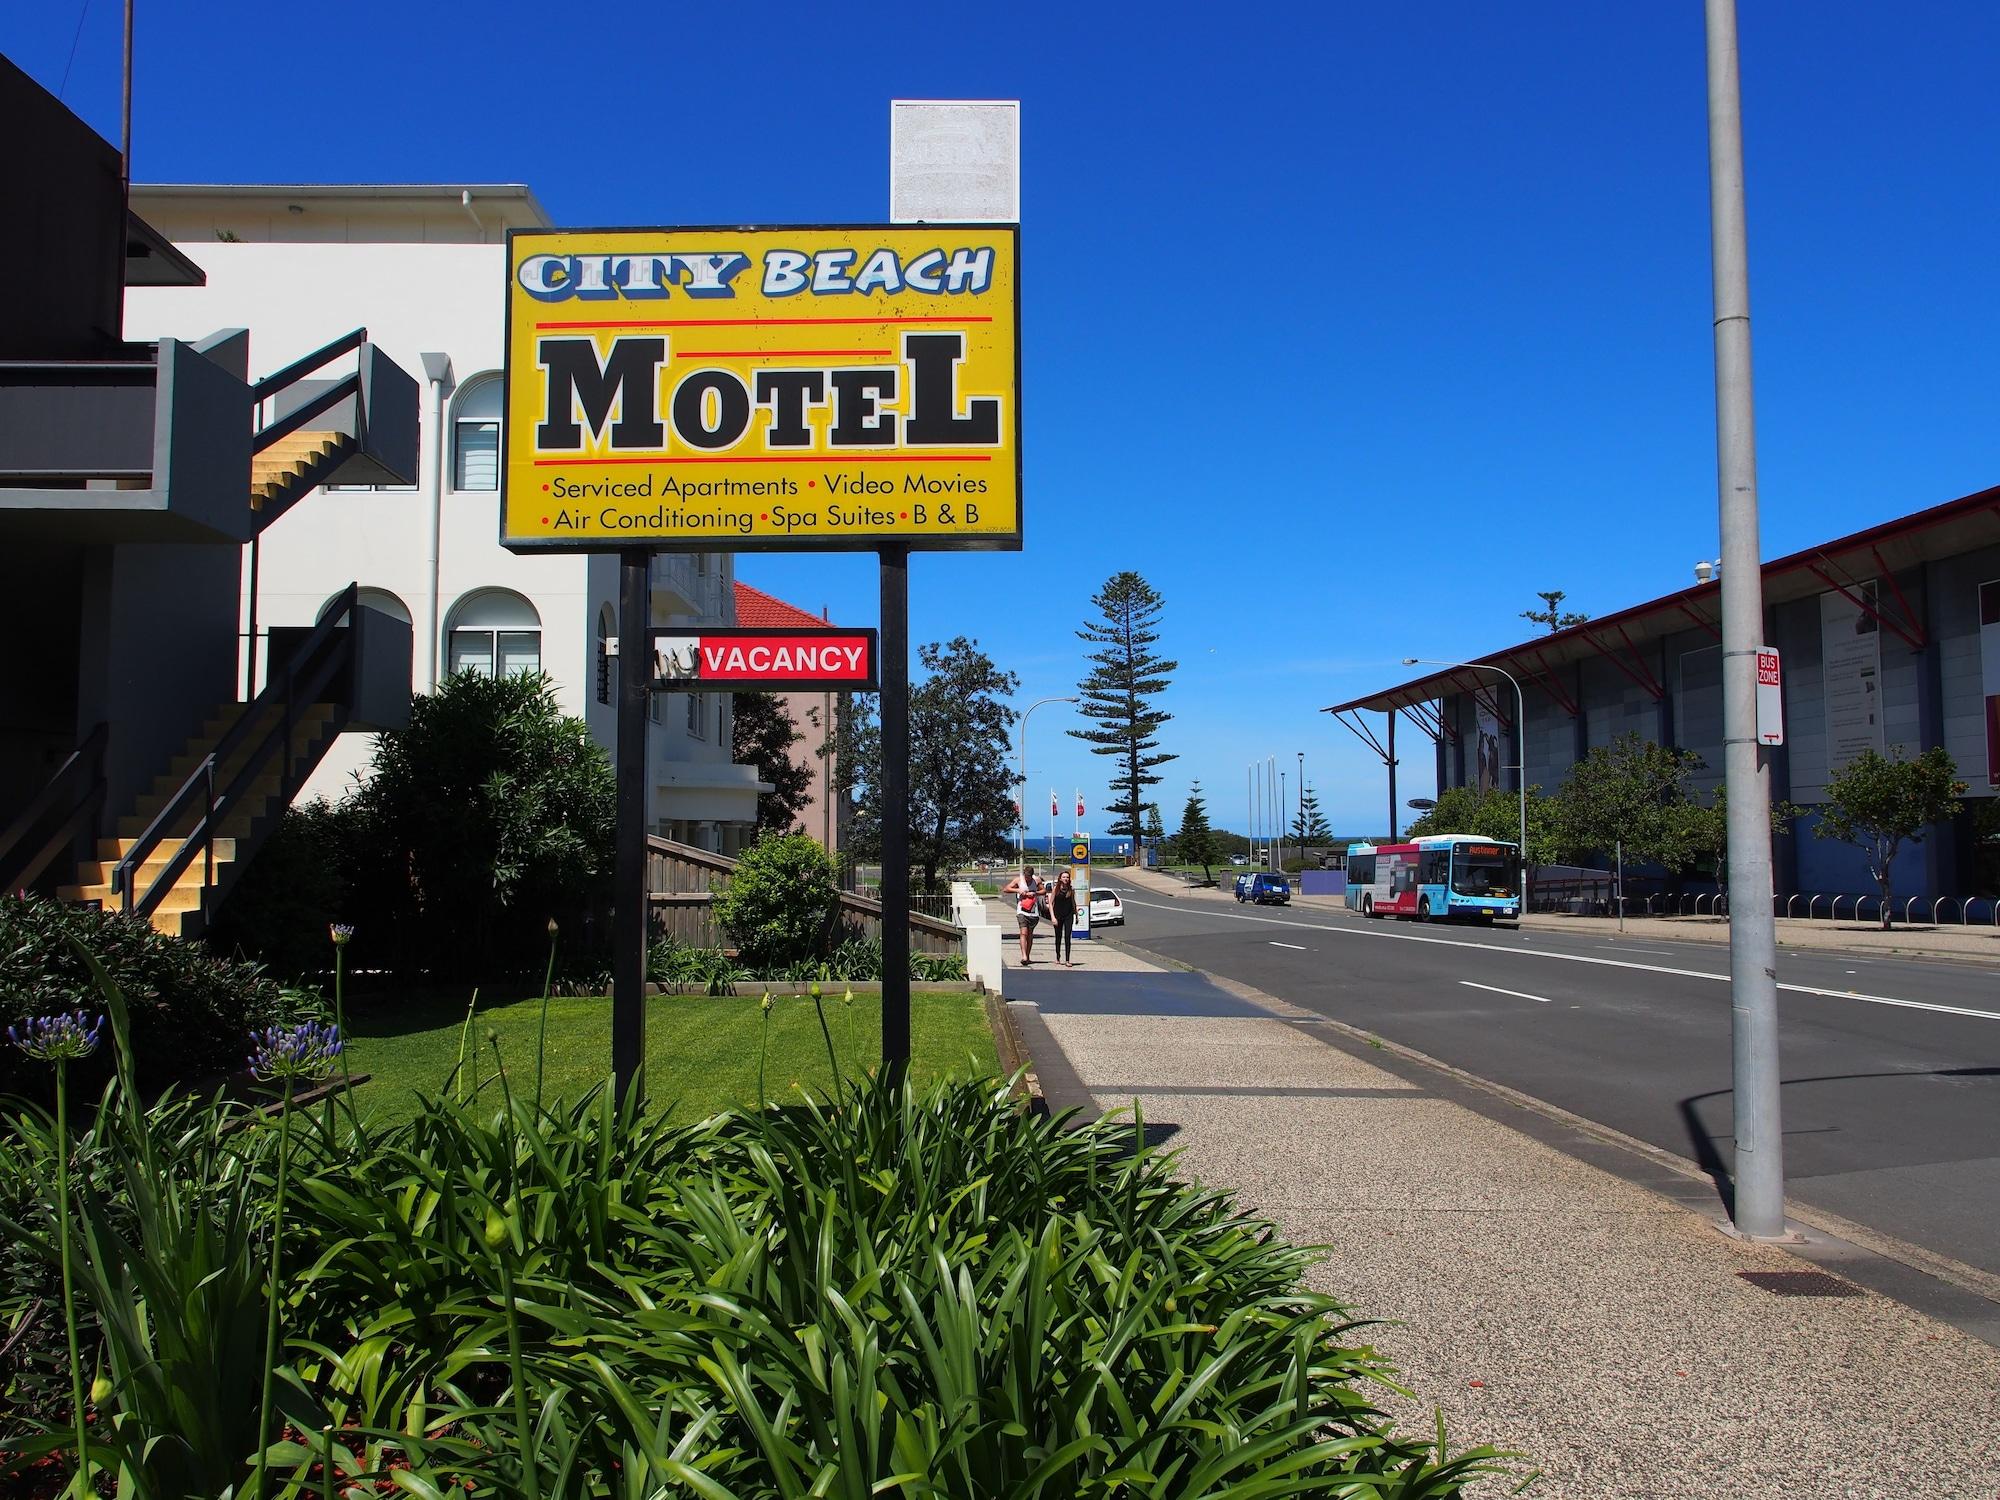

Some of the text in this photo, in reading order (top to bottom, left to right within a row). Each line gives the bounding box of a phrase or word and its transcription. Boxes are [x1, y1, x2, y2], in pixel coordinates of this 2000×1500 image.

[517, 247, 996, 303] CITY BEACH
[535, 330, 1003, 453] MOTEL
[552, 473, 798, 502] Serviced Apartments
[823, 471, 988, 495] Video Movies
[553, 505, 753, 533] Air Conditioning
[771, 505, 895, 532] Spa Suites
[914, 503, 979, 524] B & B
[705, 646, 863, 672] VACANCY
[1760, 655, 1775, 669] BUS
[1758, 669, 1778, 683] ZONE
